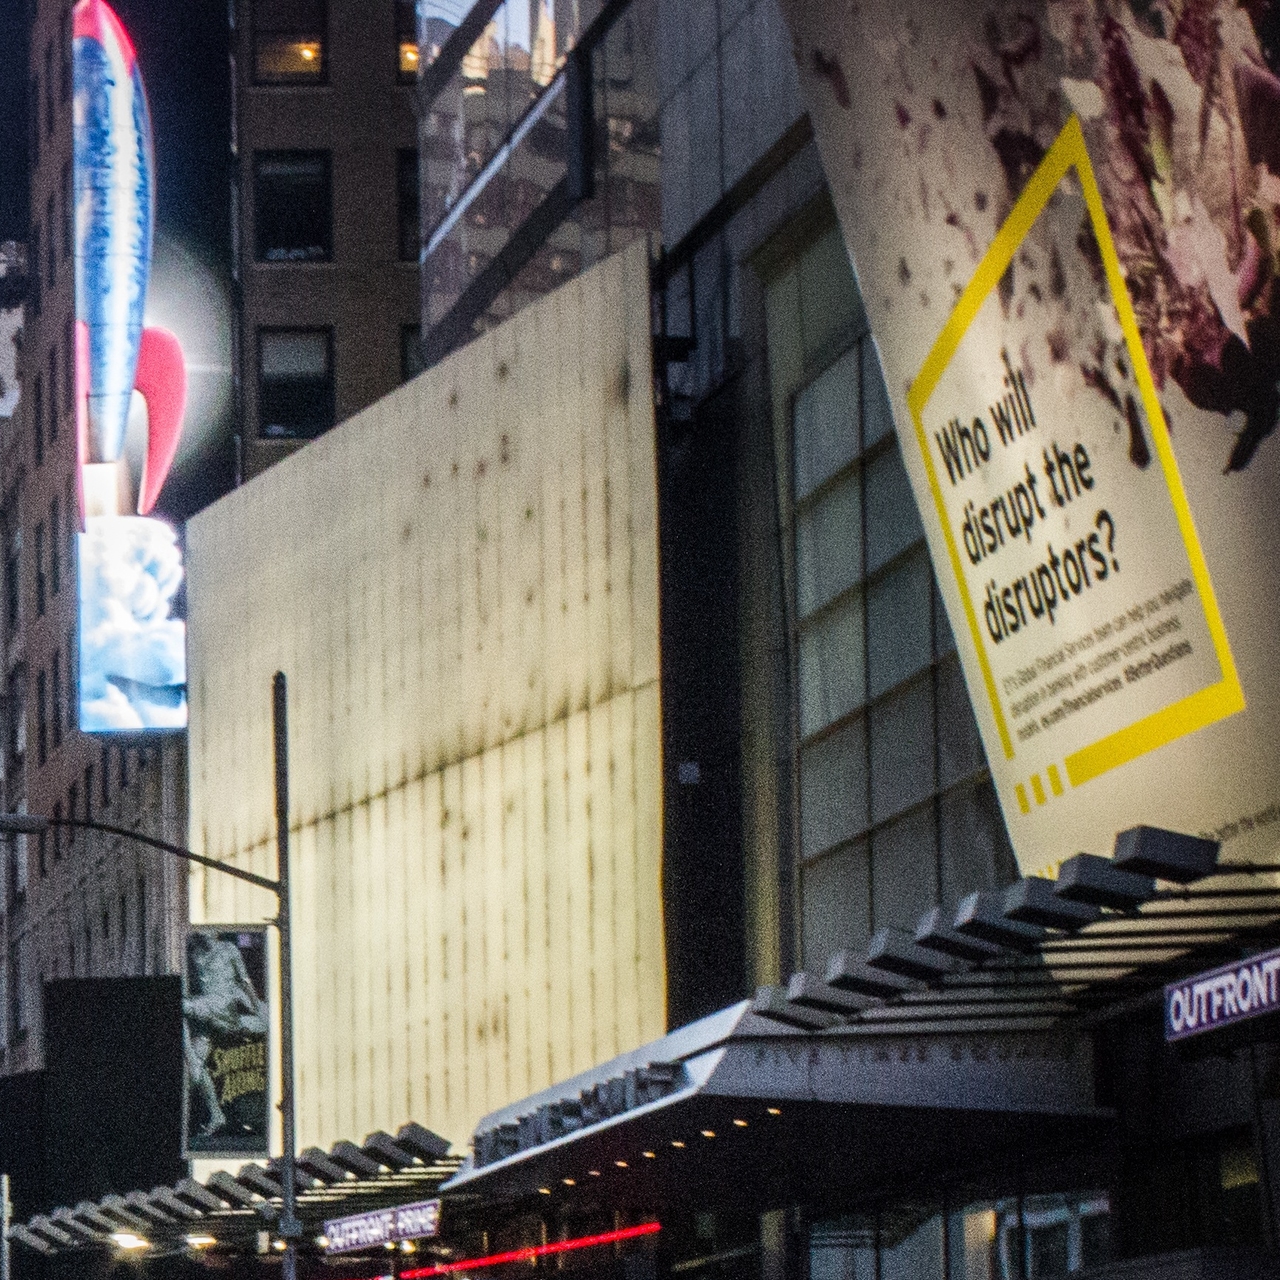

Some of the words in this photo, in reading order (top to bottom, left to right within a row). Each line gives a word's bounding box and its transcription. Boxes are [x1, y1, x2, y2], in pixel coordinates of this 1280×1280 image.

[934, 416, 991, 486] Who
[988, 364, 1037, 447] will
[962, 461, 1046, 566] disrupt
[1042, 431, 1094, 507] the
[984, 509, 1120, 646] disruptors?
[1170, 957, 1280, 1031] OUTFRONT
